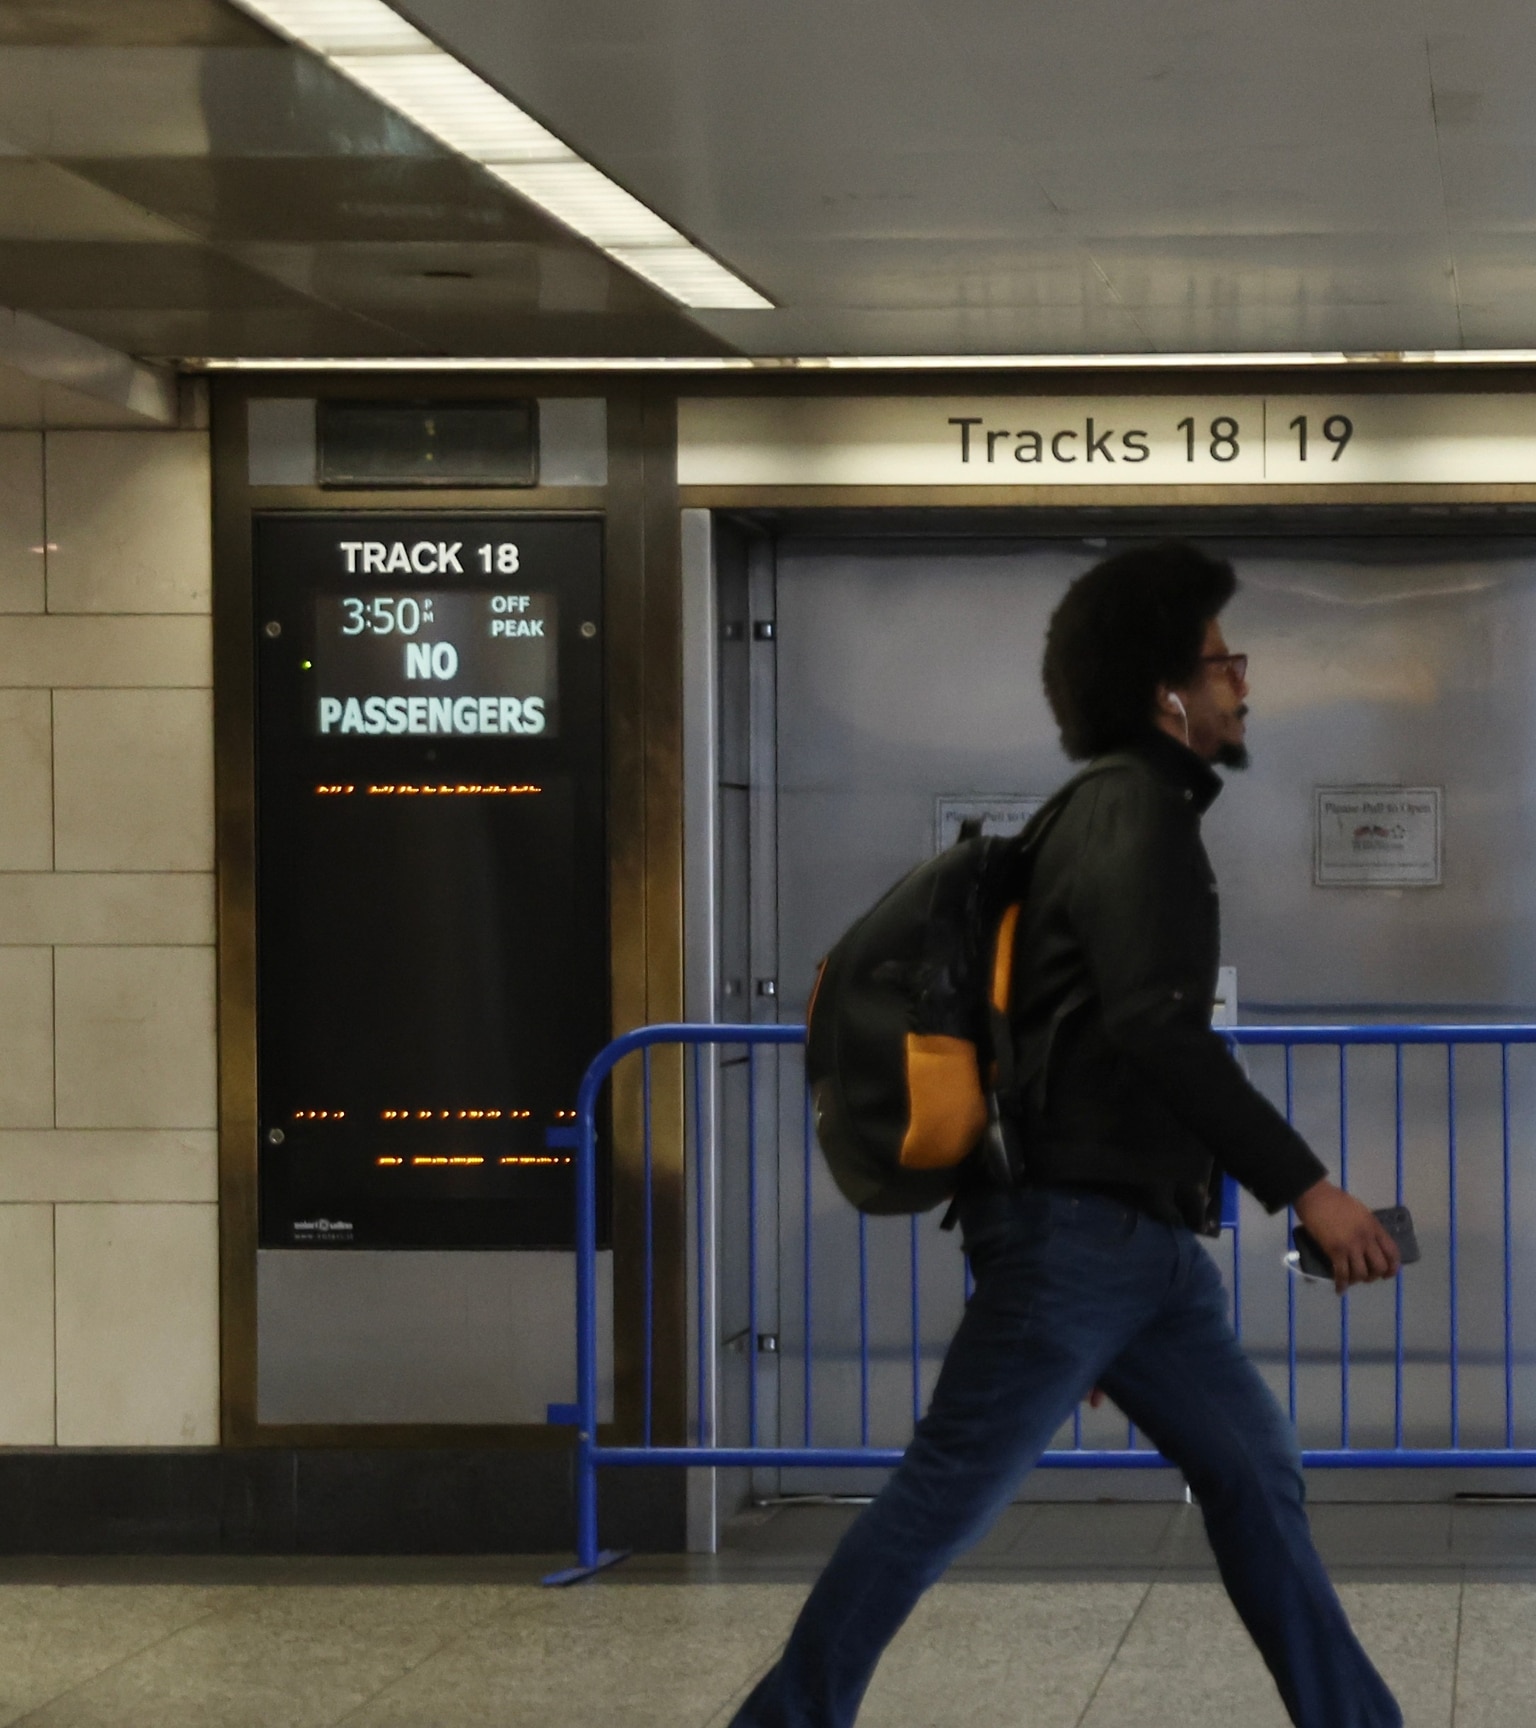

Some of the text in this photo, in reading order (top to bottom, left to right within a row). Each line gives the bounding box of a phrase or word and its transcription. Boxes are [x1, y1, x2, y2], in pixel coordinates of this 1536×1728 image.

[947, 414, 1354, 463] Tracks 18 19
[339, 541, 520, 574] TRACK 18
[342, 597, 421, 635] 3:50
[490, 595, 531, 614] OFF
[491, 619, 545, 637] PEAK
[406, 641, 458, 680] NO
[320, 696, 546, 734] PASSENGERS
